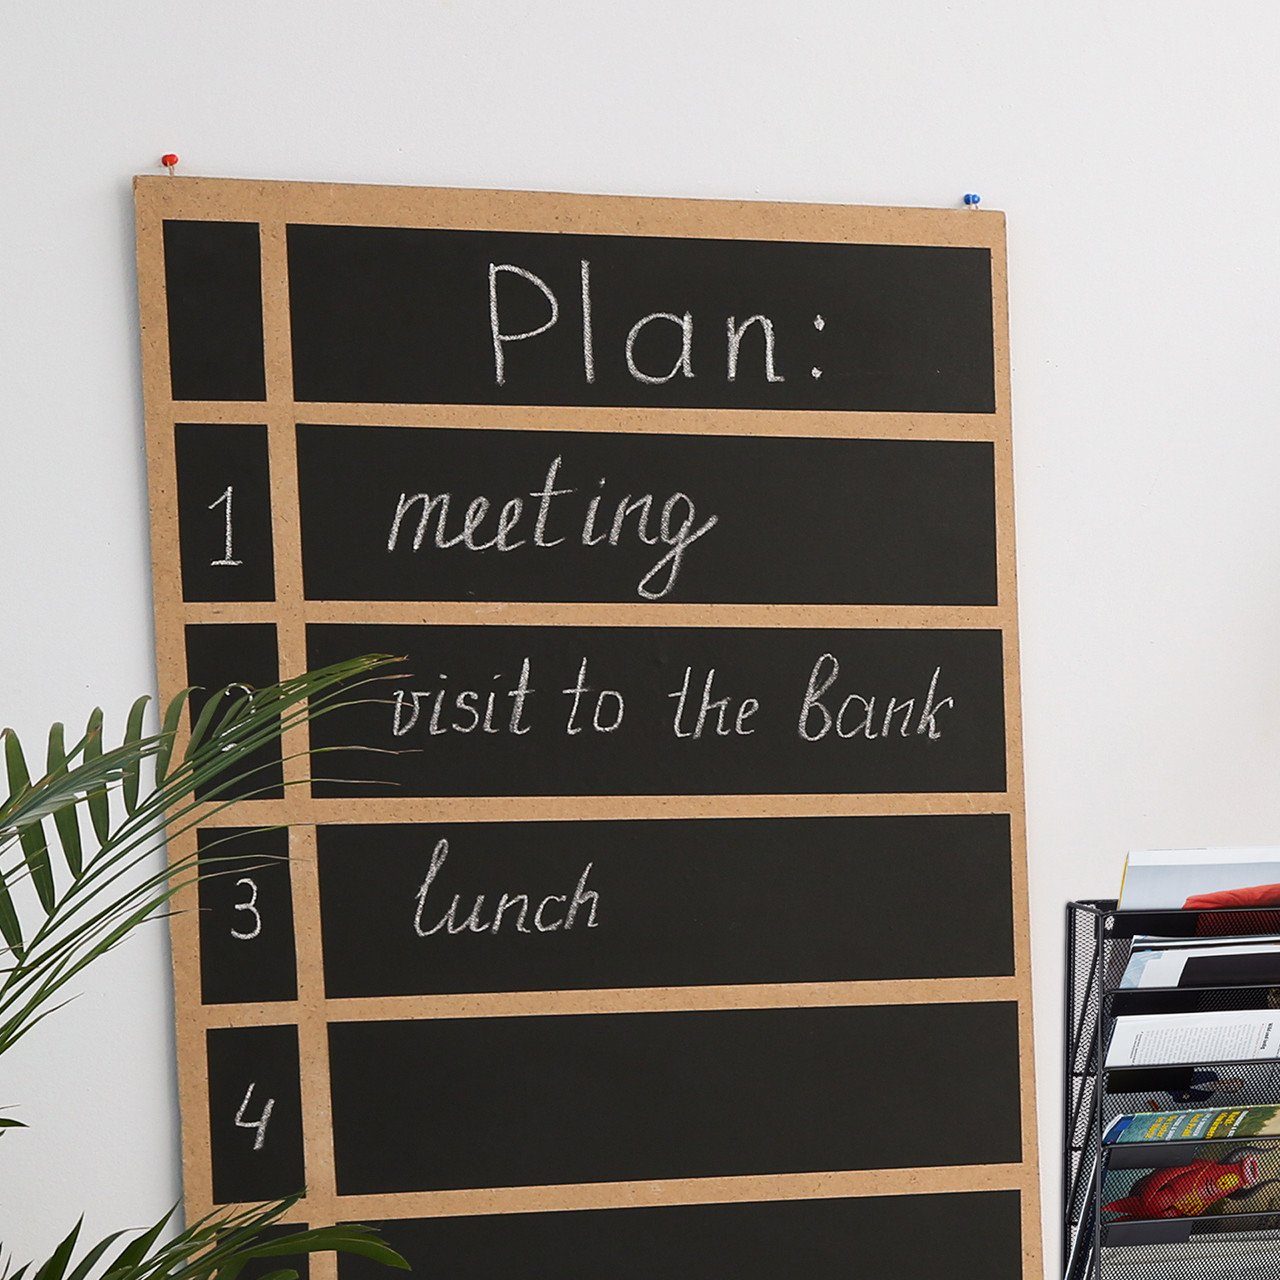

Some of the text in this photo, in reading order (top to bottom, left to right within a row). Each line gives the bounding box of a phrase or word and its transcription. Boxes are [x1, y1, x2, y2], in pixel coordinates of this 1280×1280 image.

[488, 260, 826, 387] Plan:
[208, 486, 243, 566] 1
[388, 456, 719, 600] meeting
[391, 652, 955, 742] visit to the bank
[230, 877, 262, 940] 3
[413, 838, 600, 937] lunch
[234, 1082, 276, 1151] 4
